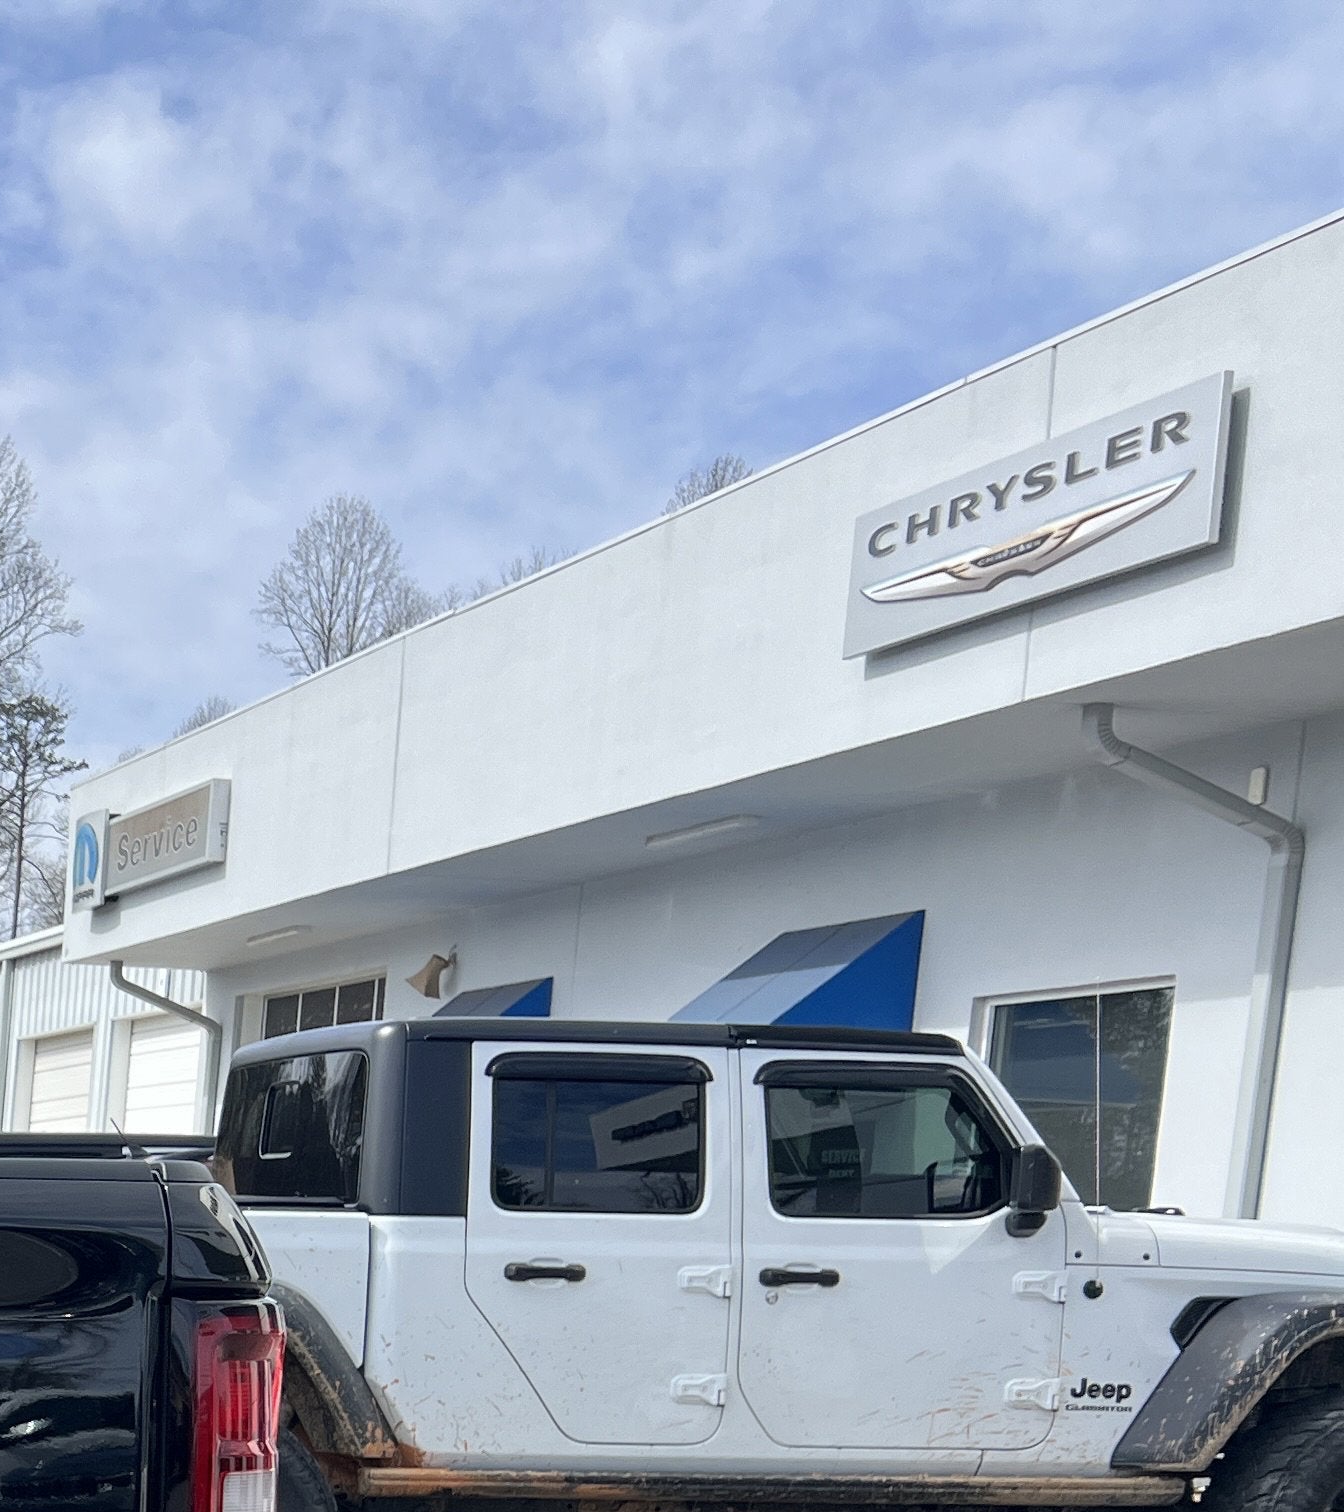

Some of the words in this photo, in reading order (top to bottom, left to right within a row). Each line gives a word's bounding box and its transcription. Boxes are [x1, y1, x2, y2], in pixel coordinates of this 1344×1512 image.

[868, 409, 1193, 559] CHRYSLER
[116, 816, 199, 872] Service
[1070, 1377, 1132, 1404] Jeep
